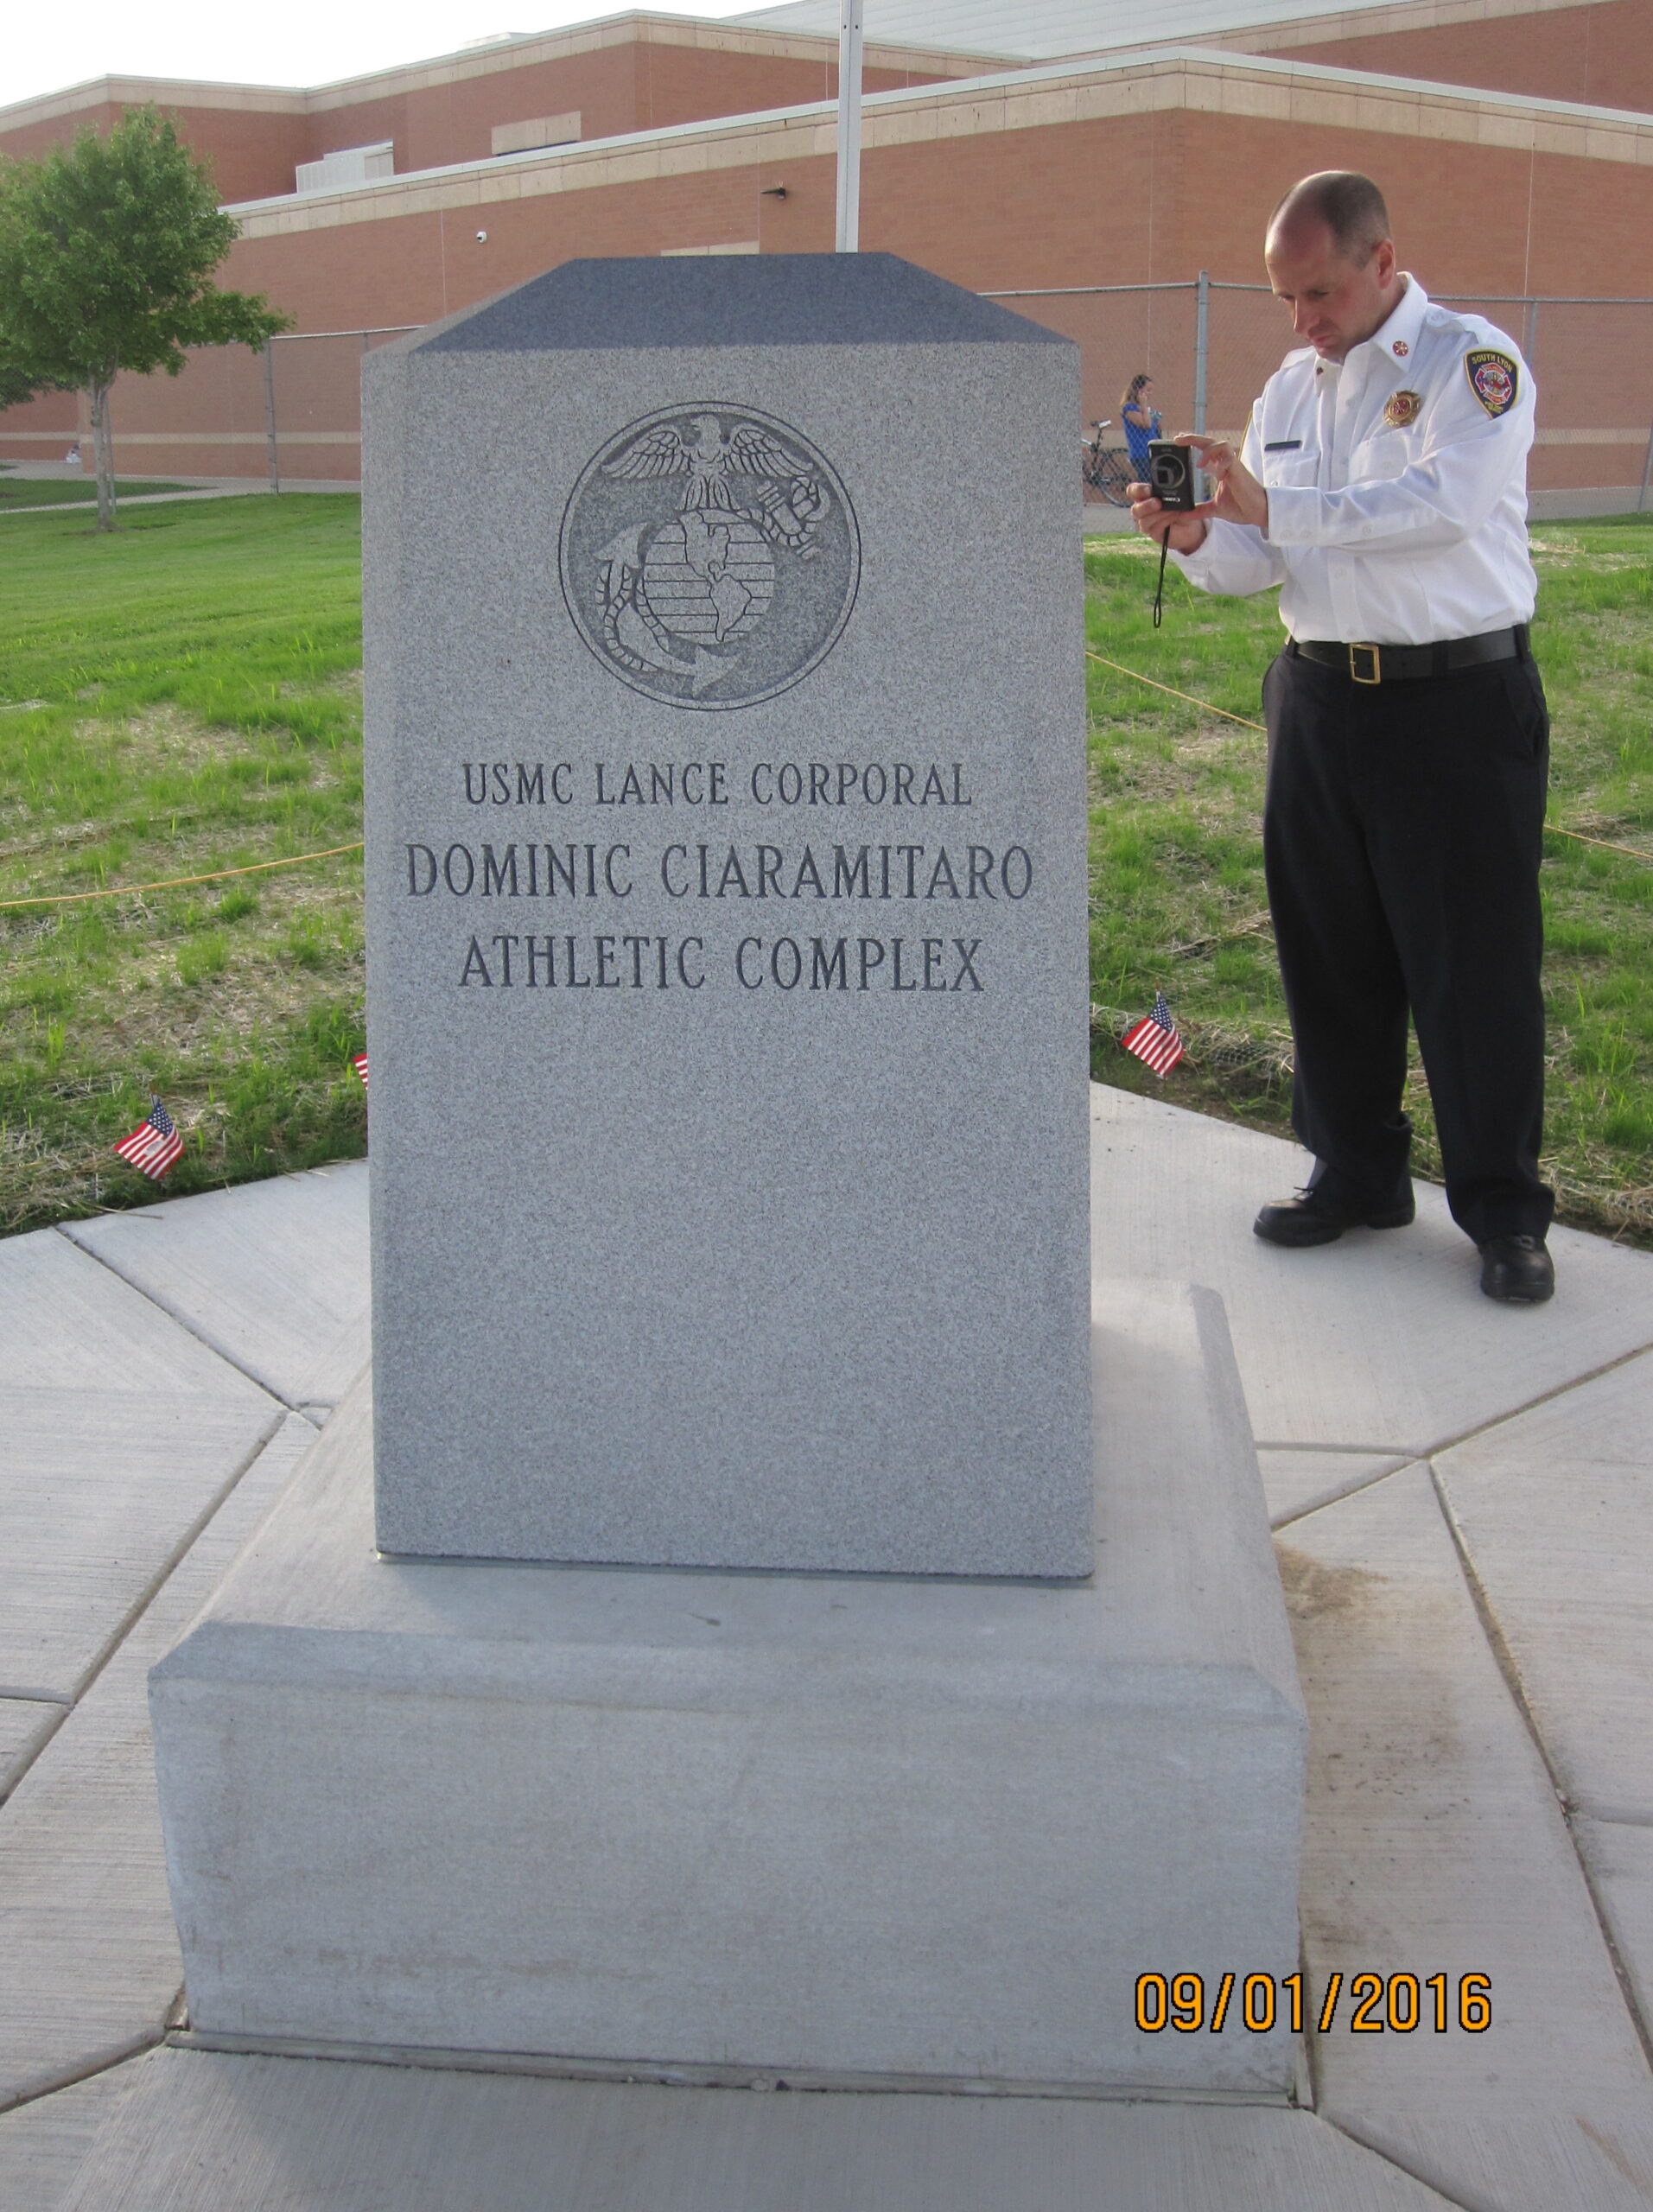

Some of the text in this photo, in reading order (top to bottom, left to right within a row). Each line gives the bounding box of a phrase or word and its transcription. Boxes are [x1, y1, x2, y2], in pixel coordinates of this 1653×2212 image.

[1472, 354, 1512, 372] SOUTH LYON
[463, 763, 972, 805] USMC LANCE CORPORAL
[405, 843, 1033, 899] DOMINIC CIARAMITARO
[458, 934, 985, 991] ATHLETIC COMPLEX
